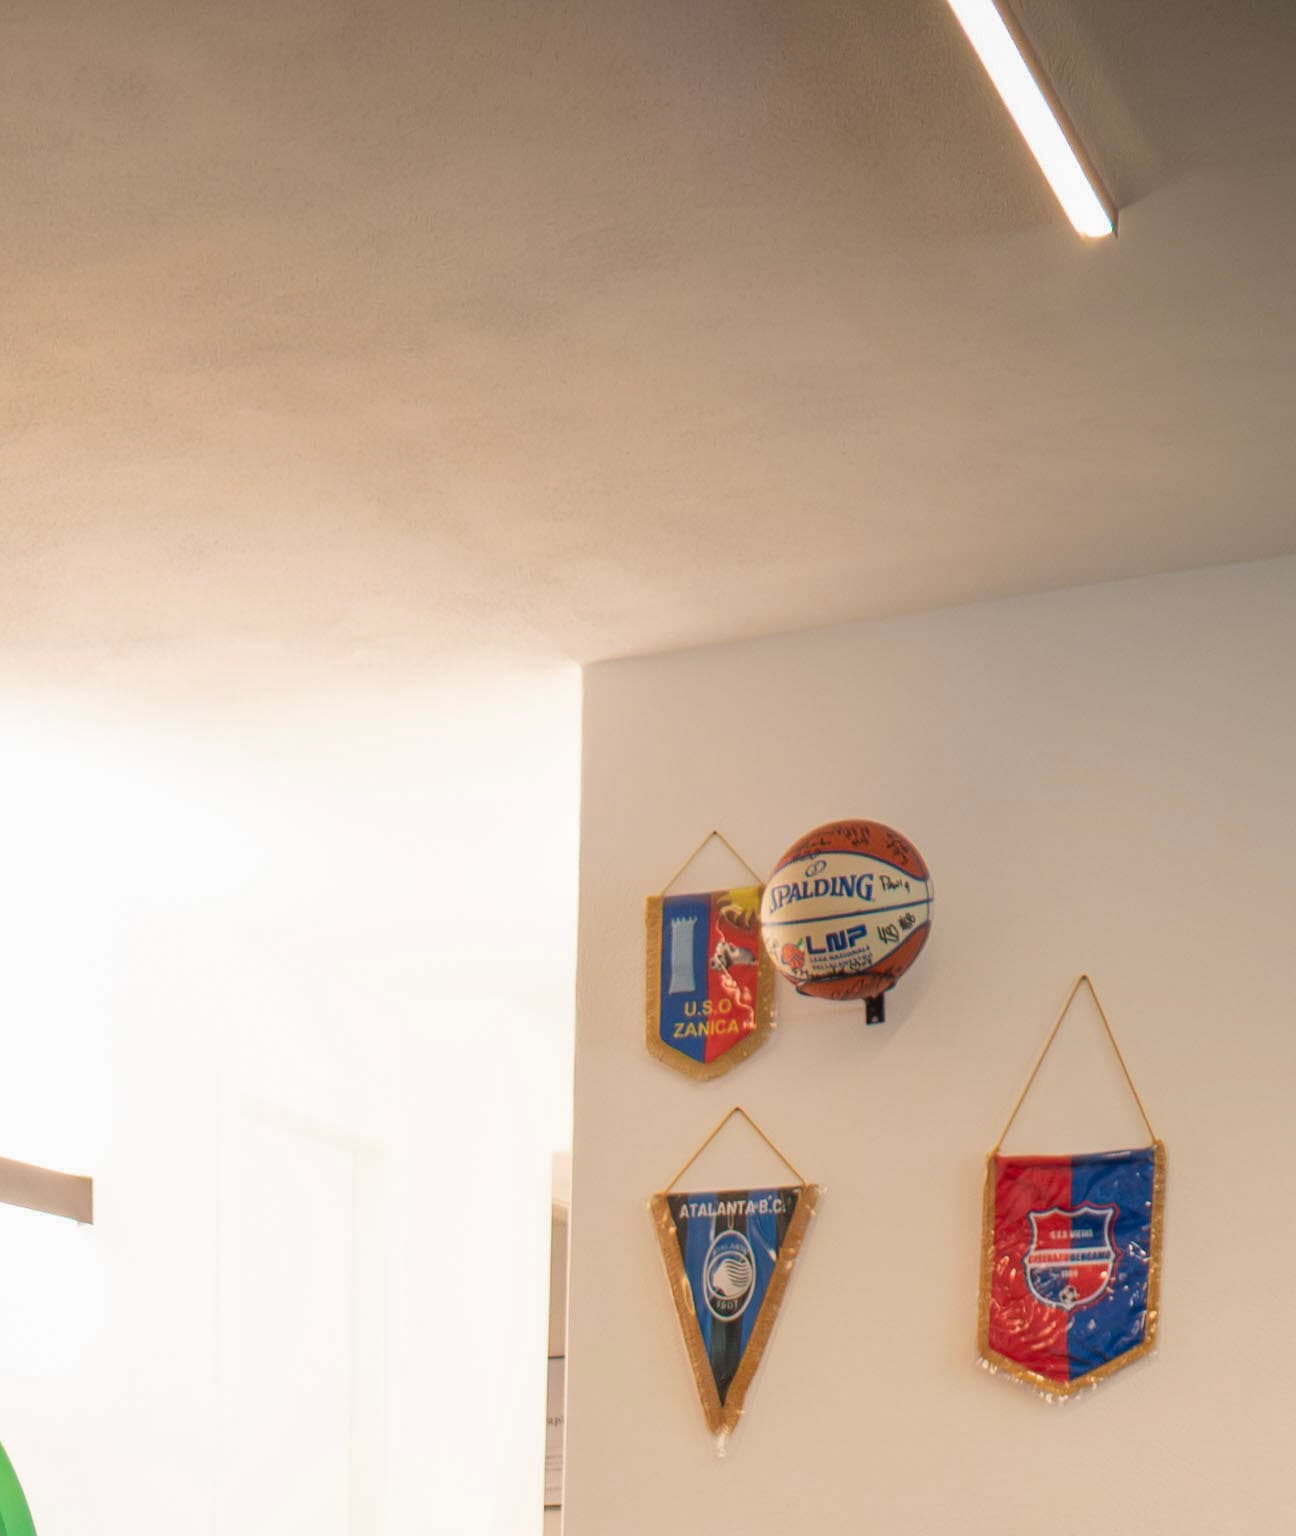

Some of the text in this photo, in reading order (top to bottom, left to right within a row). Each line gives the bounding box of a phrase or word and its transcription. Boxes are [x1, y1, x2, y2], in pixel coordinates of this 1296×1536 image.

[770, 873, 874, 913] SPALDING
[805, 923, 868, 955] LNP
[673, 1020, 739, 1038] ZANICA
[679, 1201, 756, 1218] ATALANTA
